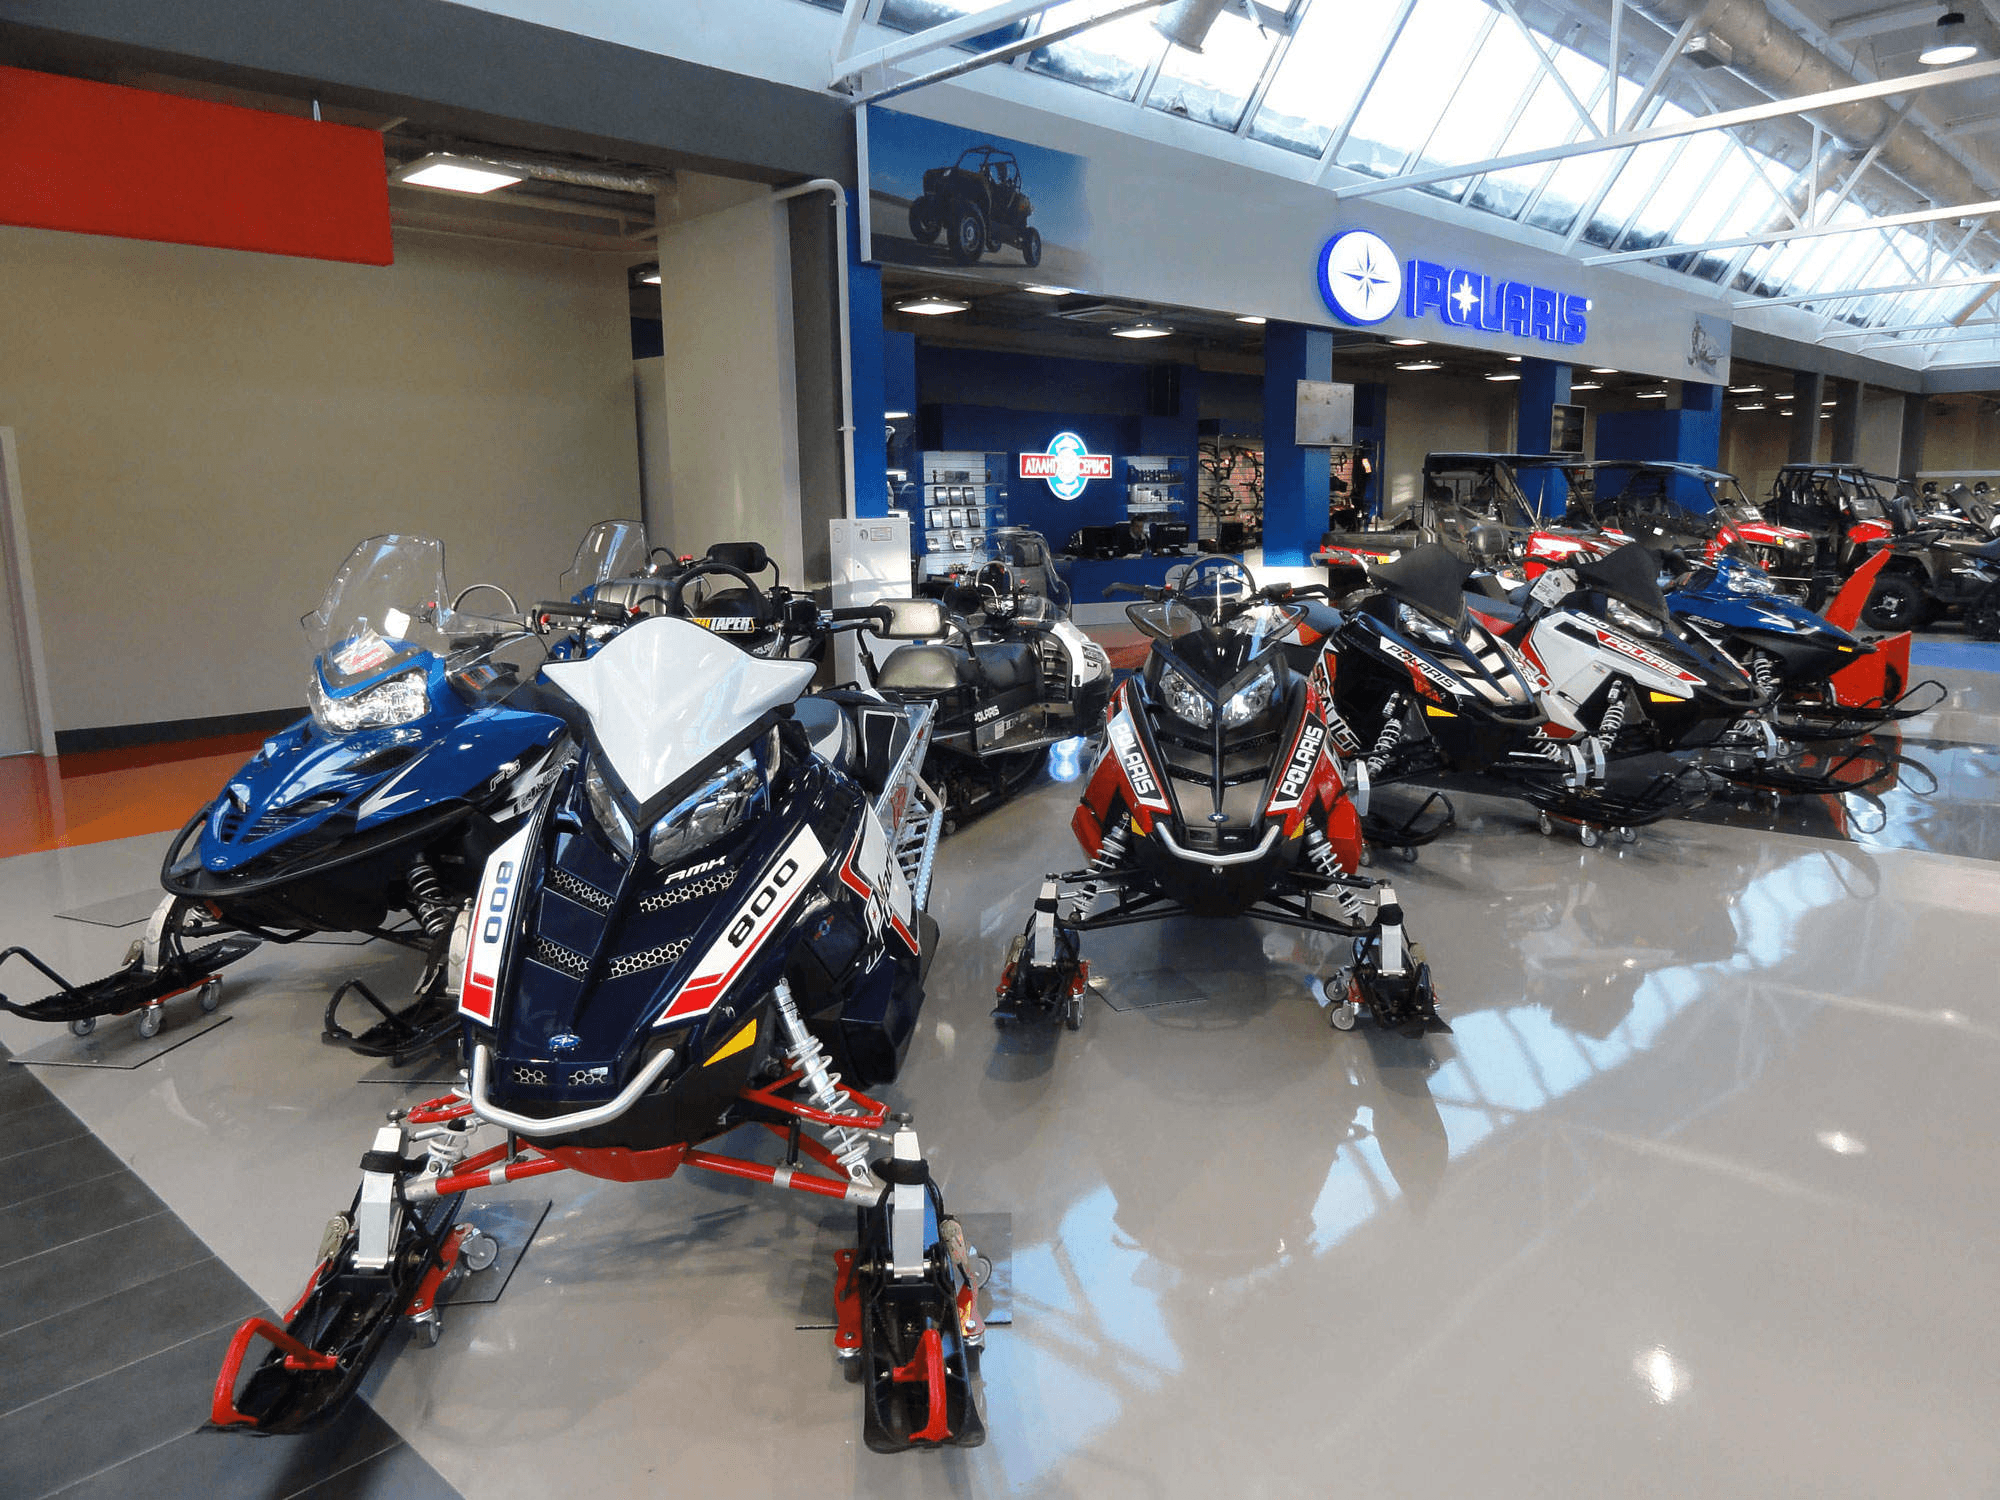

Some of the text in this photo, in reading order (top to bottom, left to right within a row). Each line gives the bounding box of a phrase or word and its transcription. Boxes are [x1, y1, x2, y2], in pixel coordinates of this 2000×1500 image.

[1407, 259, 1588, 345] POLARIS
[1386, 644, 1458, 690] POLARIS
[1603, 637, 1682, 676] POLARIS
[1112, 722, 1156, 796] POLARIS
[1280, 724, 1325, 798] POLARIS
[483, 860, 515, 944] 800
[727, 857, 799, 949] 800
